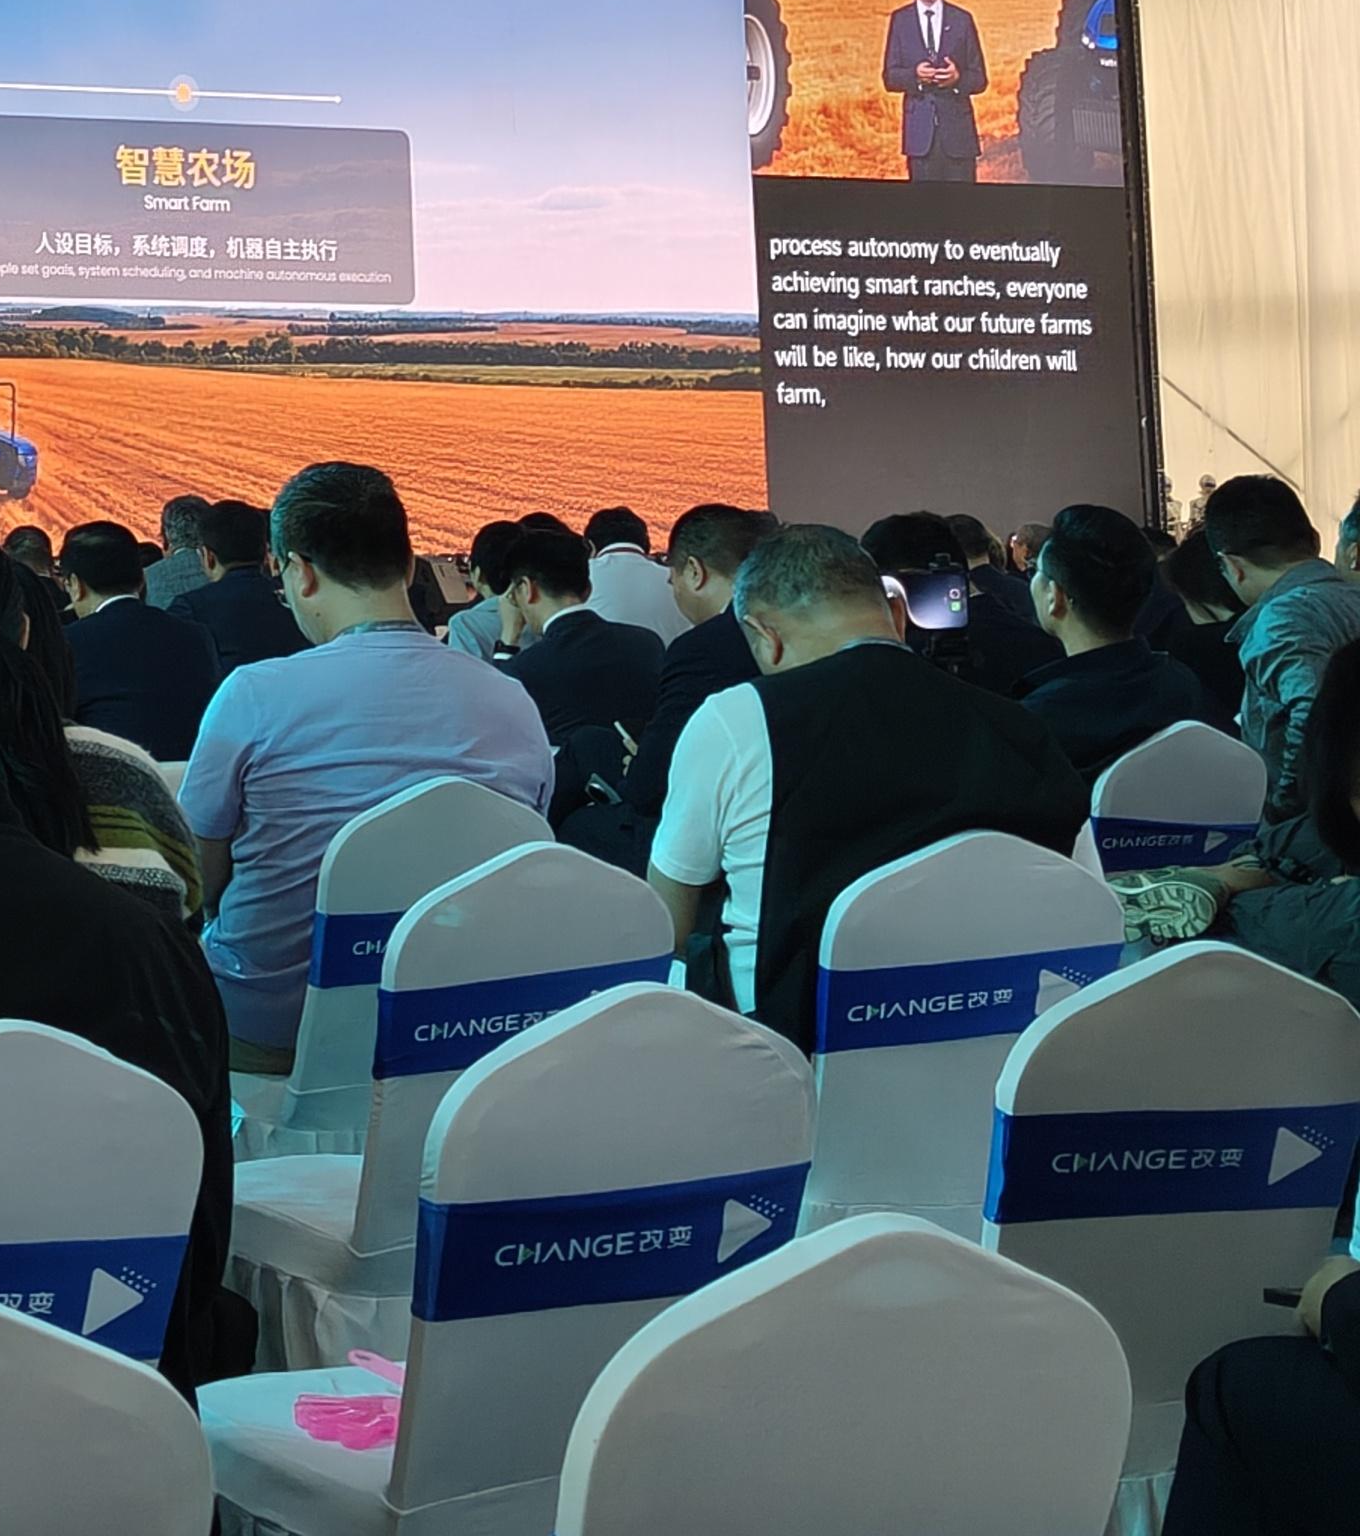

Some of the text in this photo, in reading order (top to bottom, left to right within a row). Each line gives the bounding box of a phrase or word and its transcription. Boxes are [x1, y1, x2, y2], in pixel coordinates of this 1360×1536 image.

[116, 145, 255, 189] 智慧农场
[144, 195, 230, 212] Smart Farm
[769, 237, 1060, 267] process autonomy to eventually
[21, 263, 40, 275] set
[189, 267, 211, 280] and
[772, 271, 1088, 303] achieving smart ranches, everyone
[773, 308, 1092, 337] can imagine what our future farms
[774, 346, 1078, 372] will be like, how our children will
[776, 382, 826, 408] farm,
